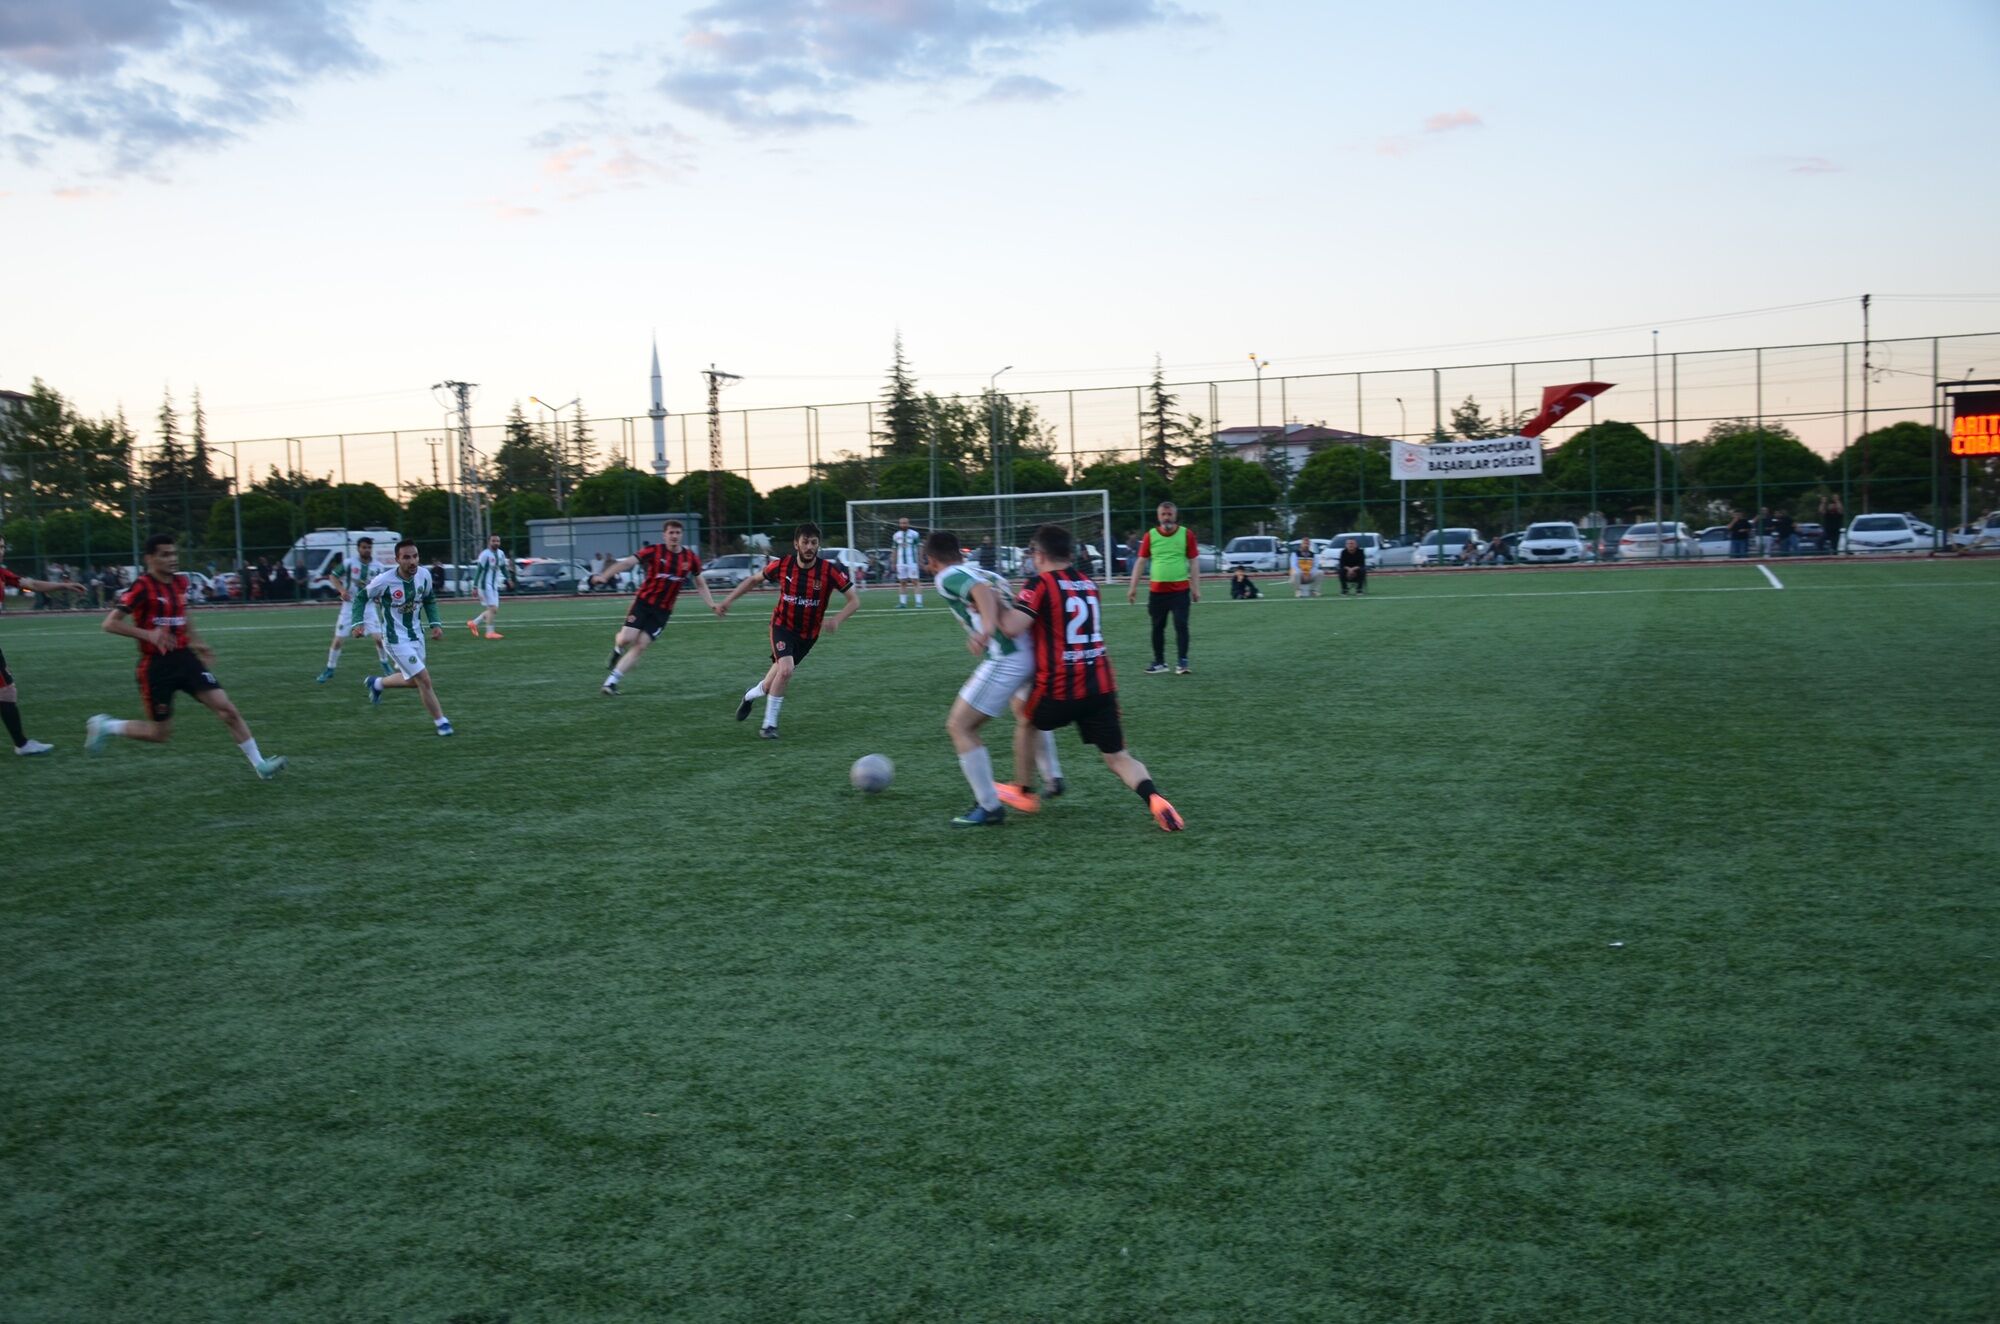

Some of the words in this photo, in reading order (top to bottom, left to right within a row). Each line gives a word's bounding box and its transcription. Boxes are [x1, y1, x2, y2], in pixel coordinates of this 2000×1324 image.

[1428, 459, 1489, 473] BAŞARILAR
[1493, 454, 1536, 467] DİLERİZ
[1065, 596, 1103, 644] 21
